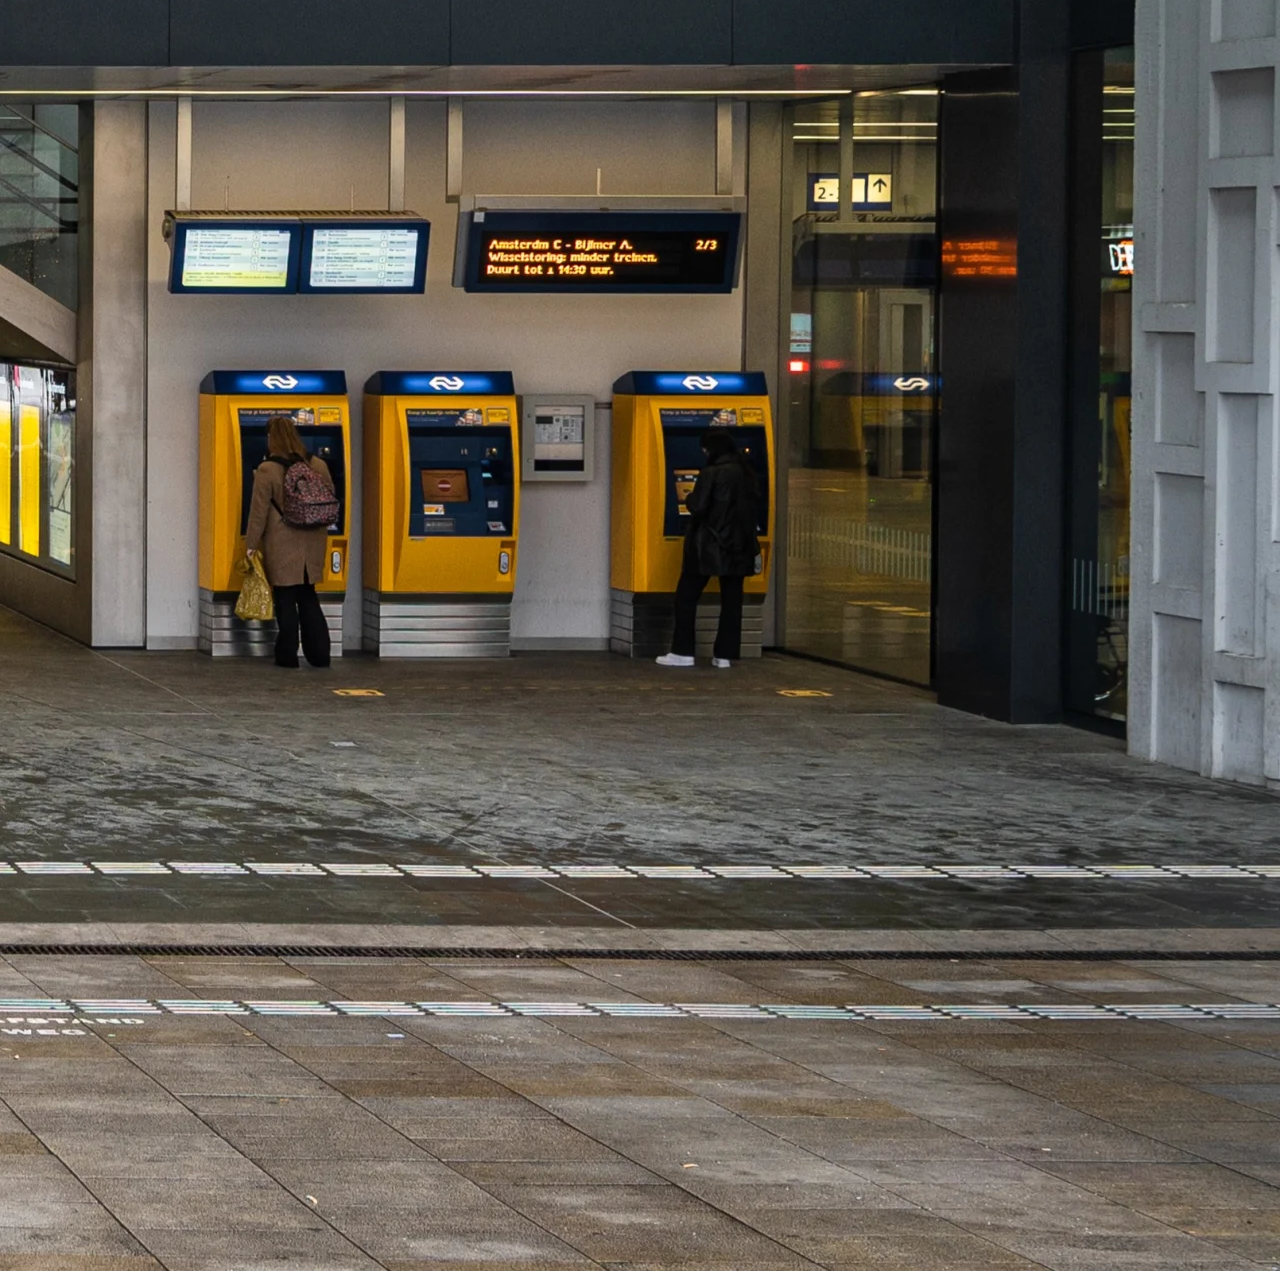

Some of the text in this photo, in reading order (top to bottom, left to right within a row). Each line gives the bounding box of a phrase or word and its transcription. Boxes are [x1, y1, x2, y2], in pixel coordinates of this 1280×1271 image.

[818, 187, 840, 200] 2-
[574, 240, 616, 250] Bijlmer
[696, 240, 717, 250] 2/3
[489, 252, 657, 264] Wisselstoring: minder treinen.
[487, 265, 520, 274] Duurt
[524, 266, 542, 274] tot
[558, 265, 586, 274] 14:30
[590, 266, 614, 275] uur.
